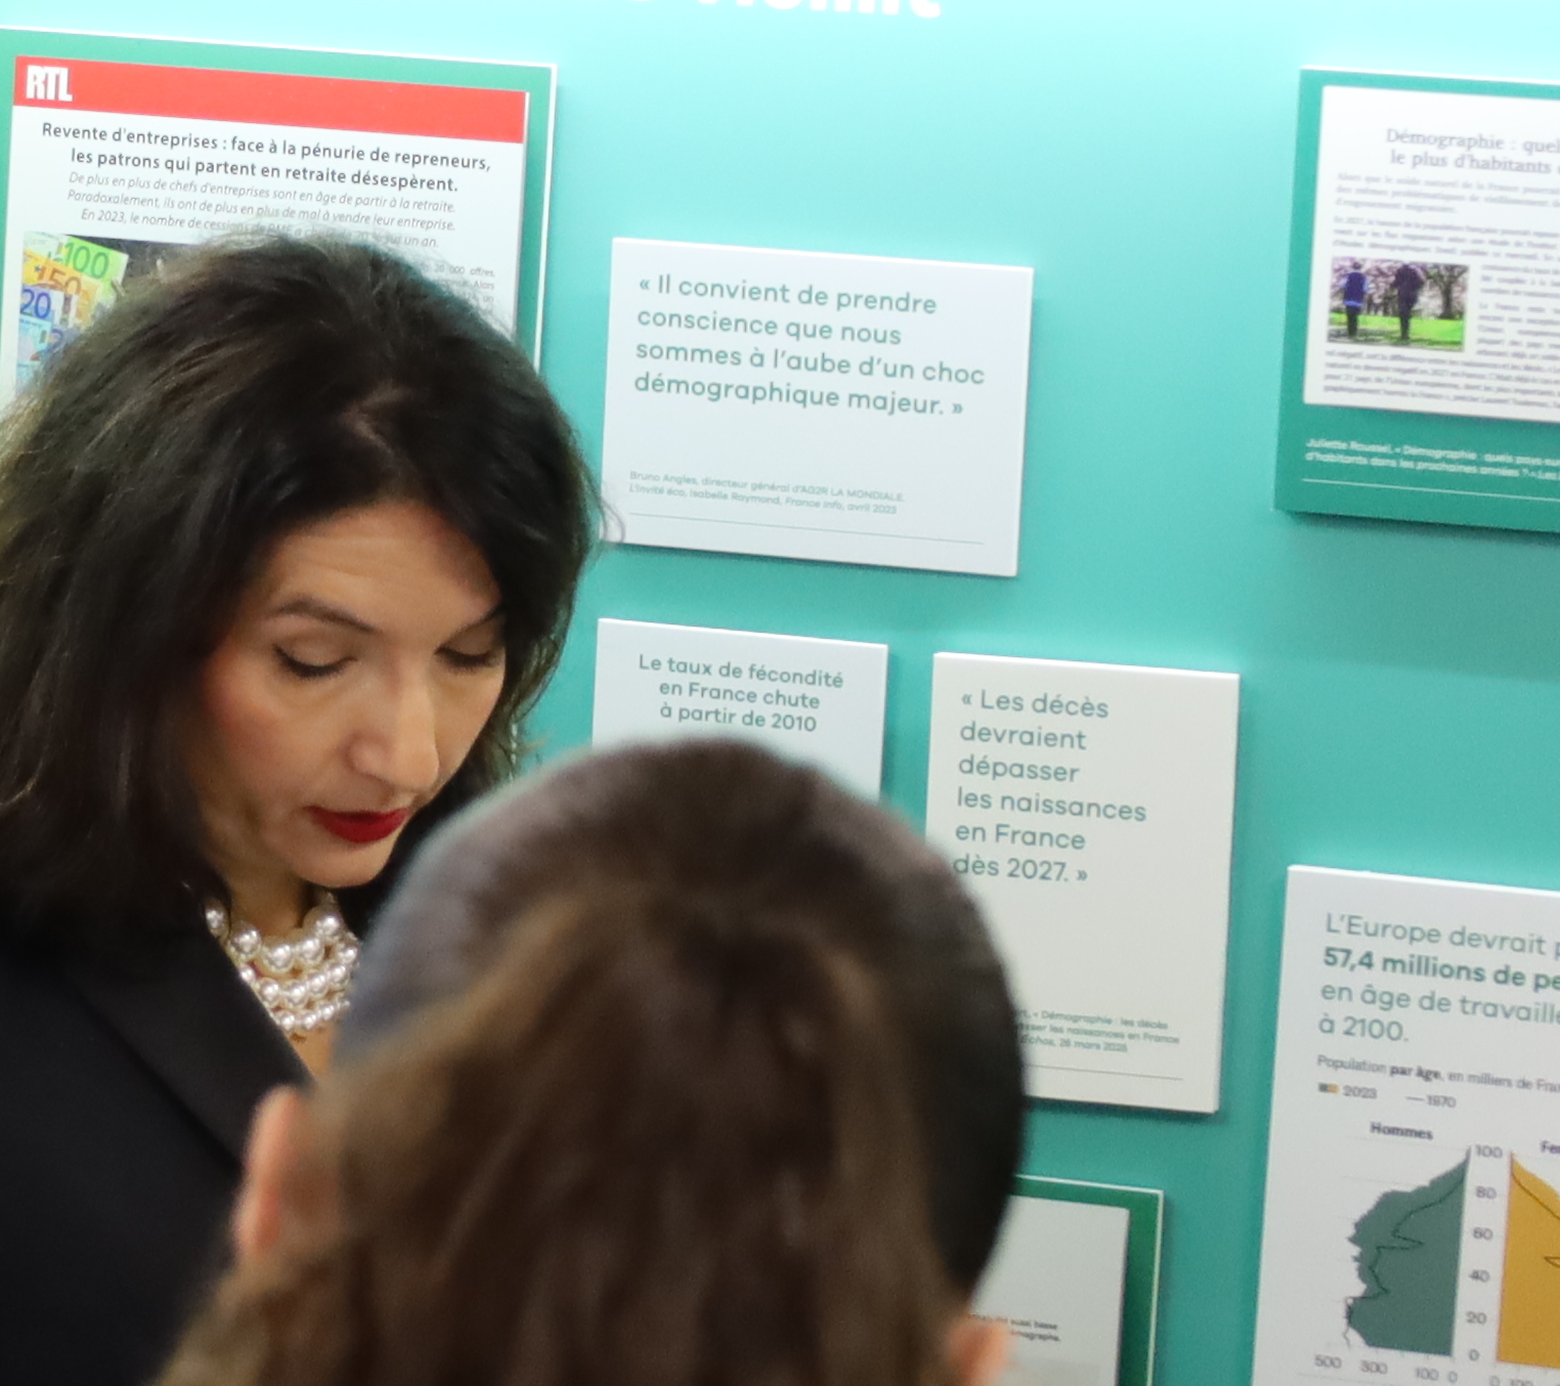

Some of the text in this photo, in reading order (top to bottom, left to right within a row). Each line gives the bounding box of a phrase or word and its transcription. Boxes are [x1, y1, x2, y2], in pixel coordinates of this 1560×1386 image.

[25, 64, 74, 103] RTL
[41, 121, 107, 140] Revente
[111, 127, 218, 149] d'entreprises
[230, 135, 264, 152] face
[268, 138, 277, 154] à
[282, 139, 296, 155] la
[300, 142, 365, 160] pénurie
[369, 146, 390, 162] de
[394, 152, 490, 171] repreneurs,
[70, 147, 457, 191] les patrons qui partent en retraite désespèrent.
[657, 275, 671, 294] Il
[677, 280, 790, 303] convient
[796, 285, 828, 306] de
[835, 292, 937, 314] prendre
[636, 310, 901, 345] conscience que nous
[635, 343, 984, 384] sommes à l'aube d'un choc
[634, 372, 840, 407] démographique
[847, 391, 943, 415] majeur.
[638, 653, 843, 688] Le taux de fécondité
[658, 681, 820, 709] en France chute
[980, 689, 1024, 712] Les
[1030, 693, 1108, 718] décès
[659, 701, 817, 732] à partir de 2010
[959, 721, 1086, 749] devraient
[958, 754, 1079, 782] dépasser
[956, 786, 1146, 821] les naissances
[954, 824, 1085, 850] en France
[951, 853, 999, 876] dès
[1006, 857, 1068, 881] 2027.
[1325, 913, 1441, 945] L'Europe
[1447, 926, 1546, 955] devrait
[1323, 946, 1374, 971] 57,4
[1381, 955, 1486, 982] millions
[1492, 964, 1526, 986] de
[1320, 983, 1353, 1002] en
[1359, 983, 1411, 1011] âge
[1417, 990, 1451, 1013] de
[1317, 1014, 1408, 1041] à 2100.
[1369, 1121, 1434, 1141] Hommes
